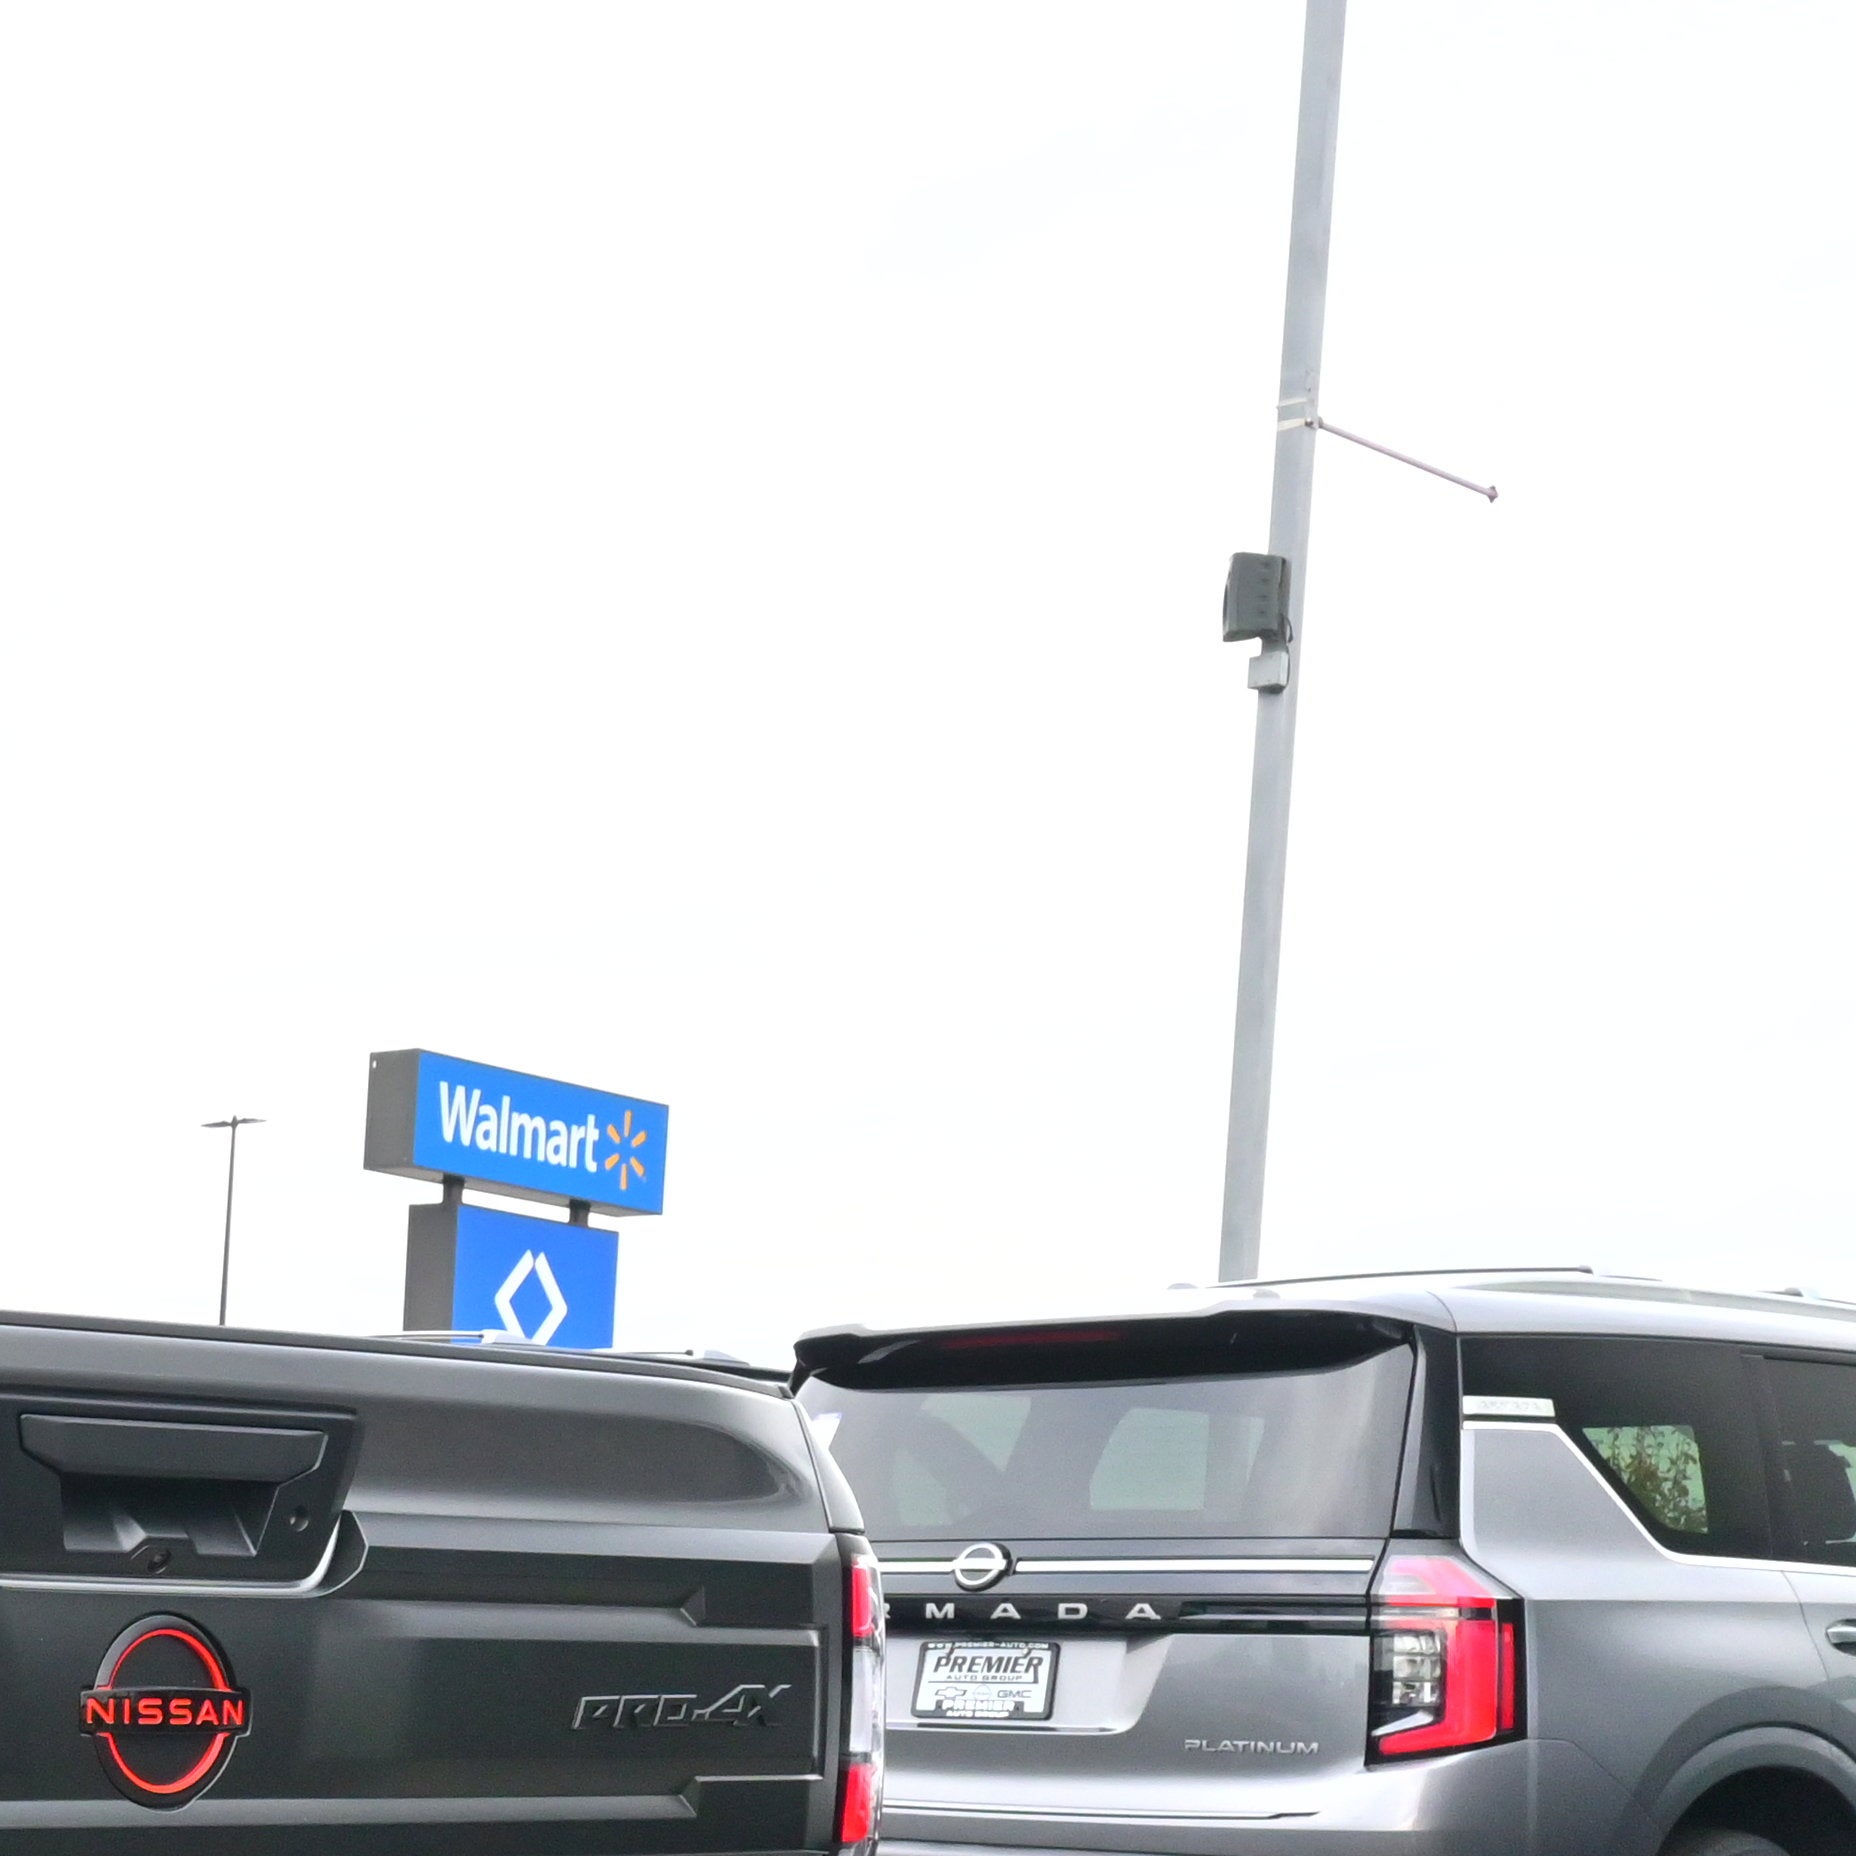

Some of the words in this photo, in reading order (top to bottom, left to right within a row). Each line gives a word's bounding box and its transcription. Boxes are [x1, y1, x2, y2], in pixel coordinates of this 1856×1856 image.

[439, 1081, 600, 1173] Walmart
[933, 1655, 1044, 1674] PREMIER
[997, 1689, 1032, 1699] GMC
[86, 1698, 245, 1726] NISSAN
[941, 1700, 1016, 1712] PREMIER
[1184, 1739, 1320, 1754] PLATINUM
